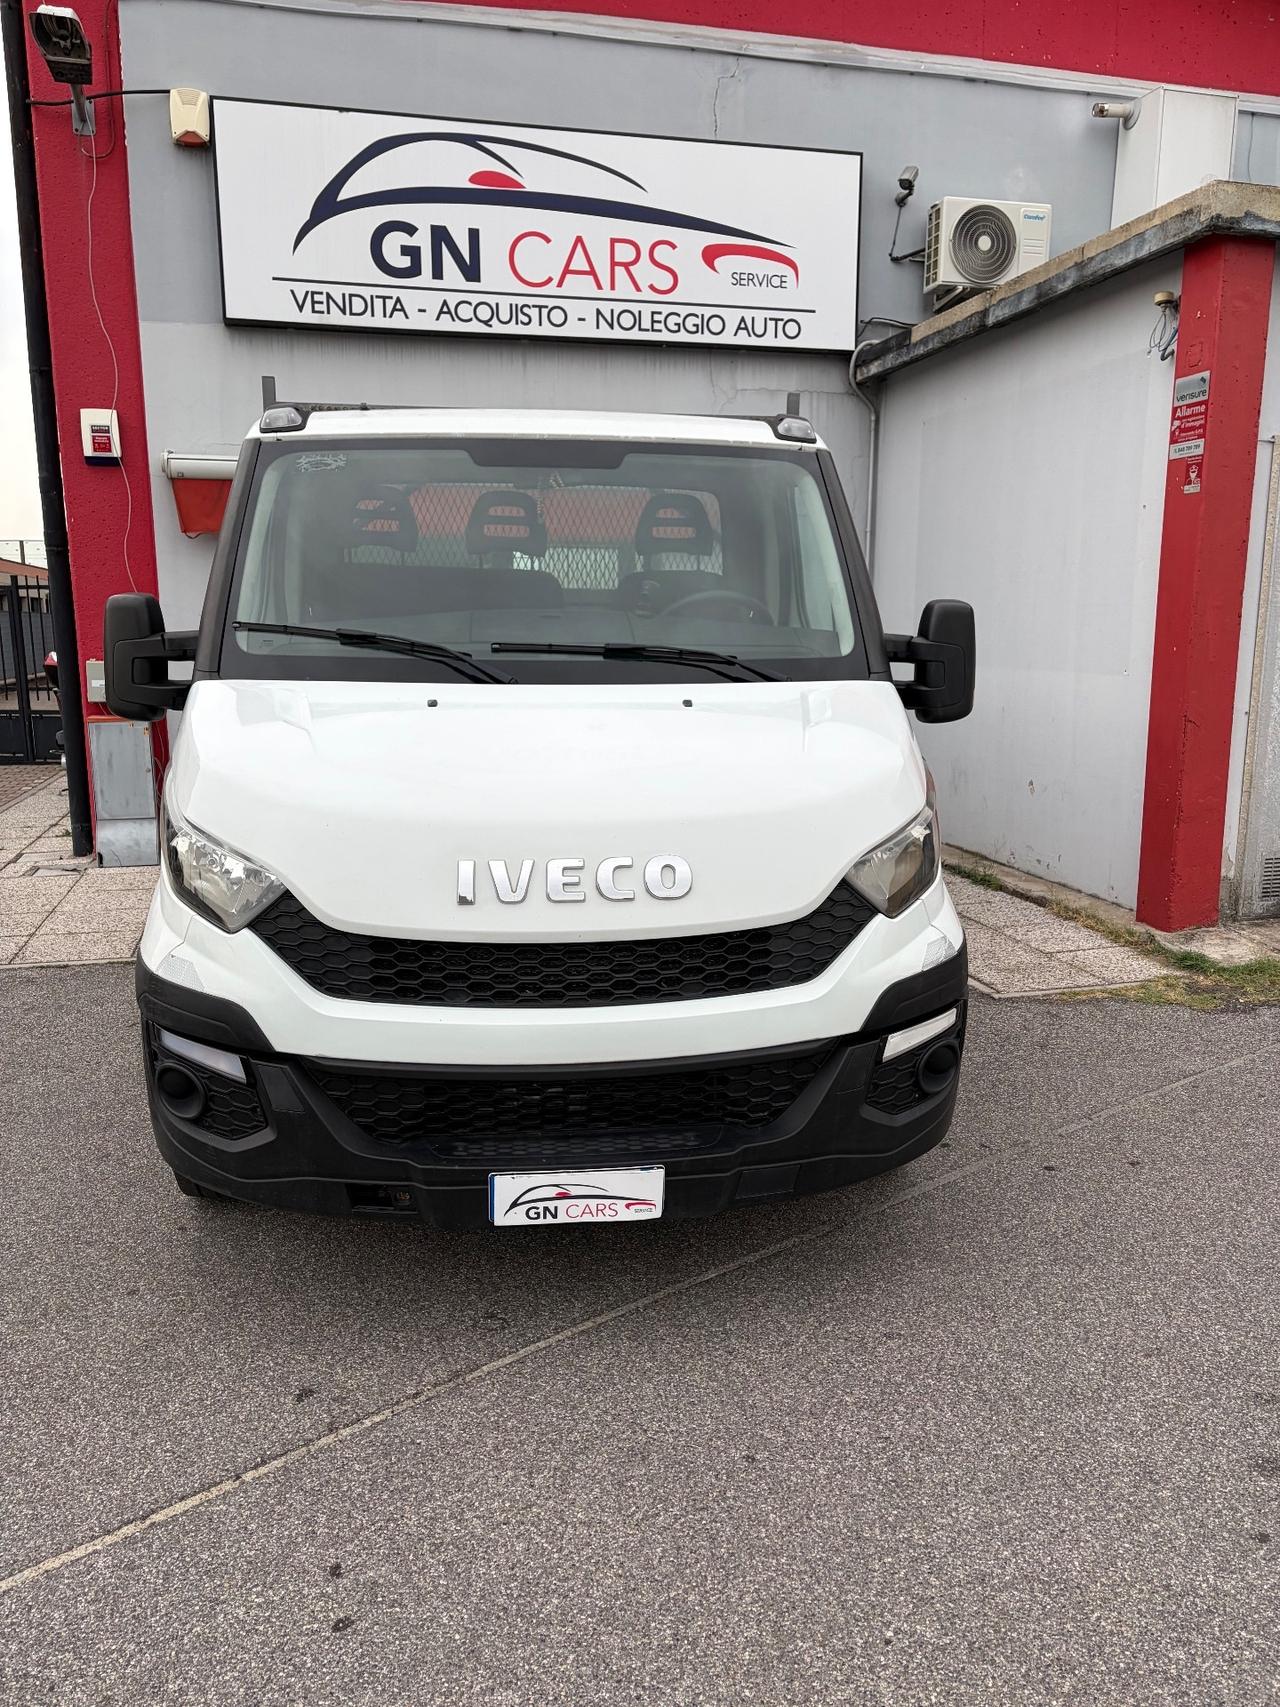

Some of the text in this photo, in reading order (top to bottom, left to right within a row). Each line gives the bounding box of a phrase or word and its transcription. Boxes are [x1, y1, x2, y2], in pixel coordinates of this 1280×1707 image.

[369, 220, 680, 295] GN CARS
[731, 271, 788, 290] SERVICE
[290, 288, 408, 320] VENDITA
[435, 299, 568, 328] ACQUISTO
[596, 308, 726, 336] NOLEGGIO
[733, 316, 802, 340] AUTO
[1176, 388, 1207, 402] verisure
[1175, 404, 1206, 418] Allarme
[457, 854, 693, 905] IVECO
[525, 1205, 558, 1220] GN
[565, 1202, 619, 1219] CARS
